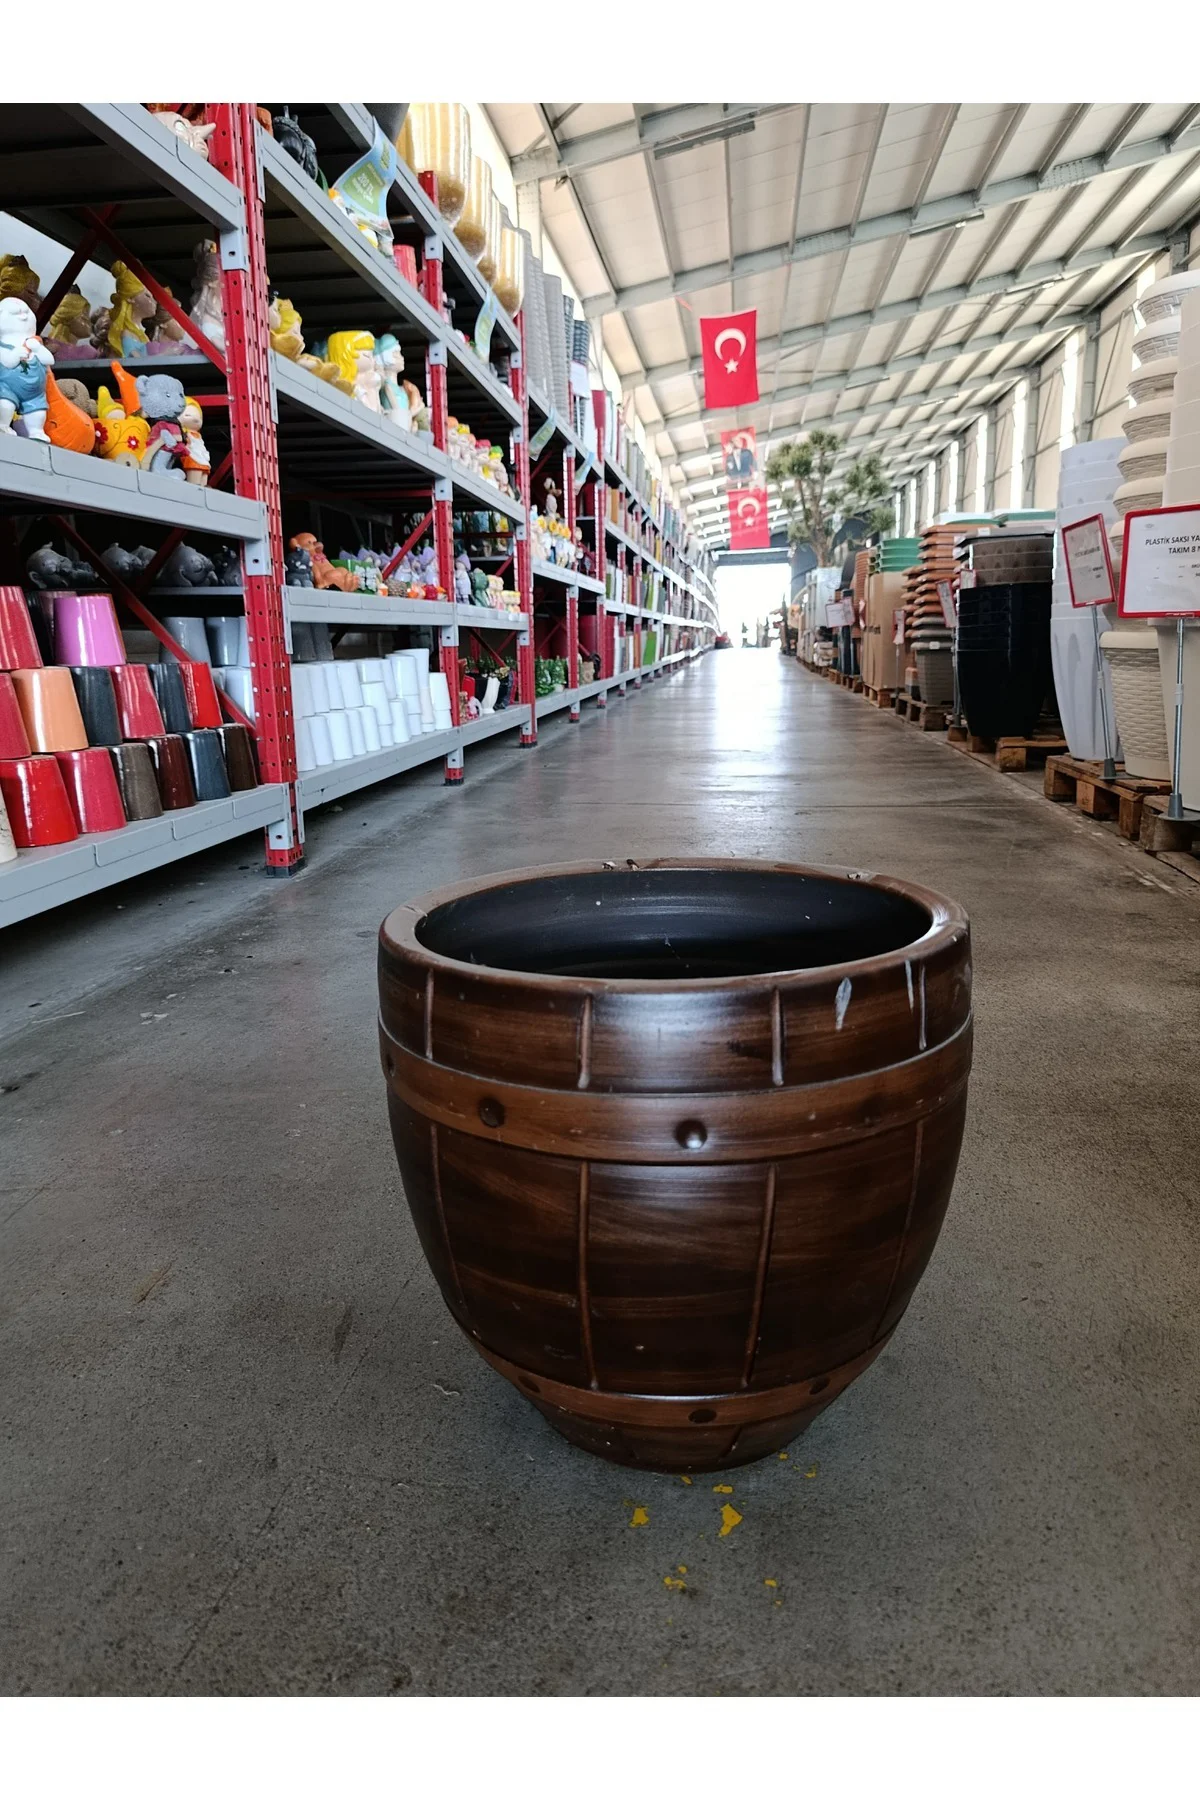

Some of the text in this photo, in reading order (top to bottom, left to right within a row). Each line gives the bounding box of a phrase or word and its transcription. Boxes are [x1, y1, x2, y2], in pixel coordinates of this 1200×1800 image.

[1145, 536, 1170, 546] PLASTİK
[1171, 535, 1189, 544] SAKSI
[1168, 546, 1190, 554] TAKIM
